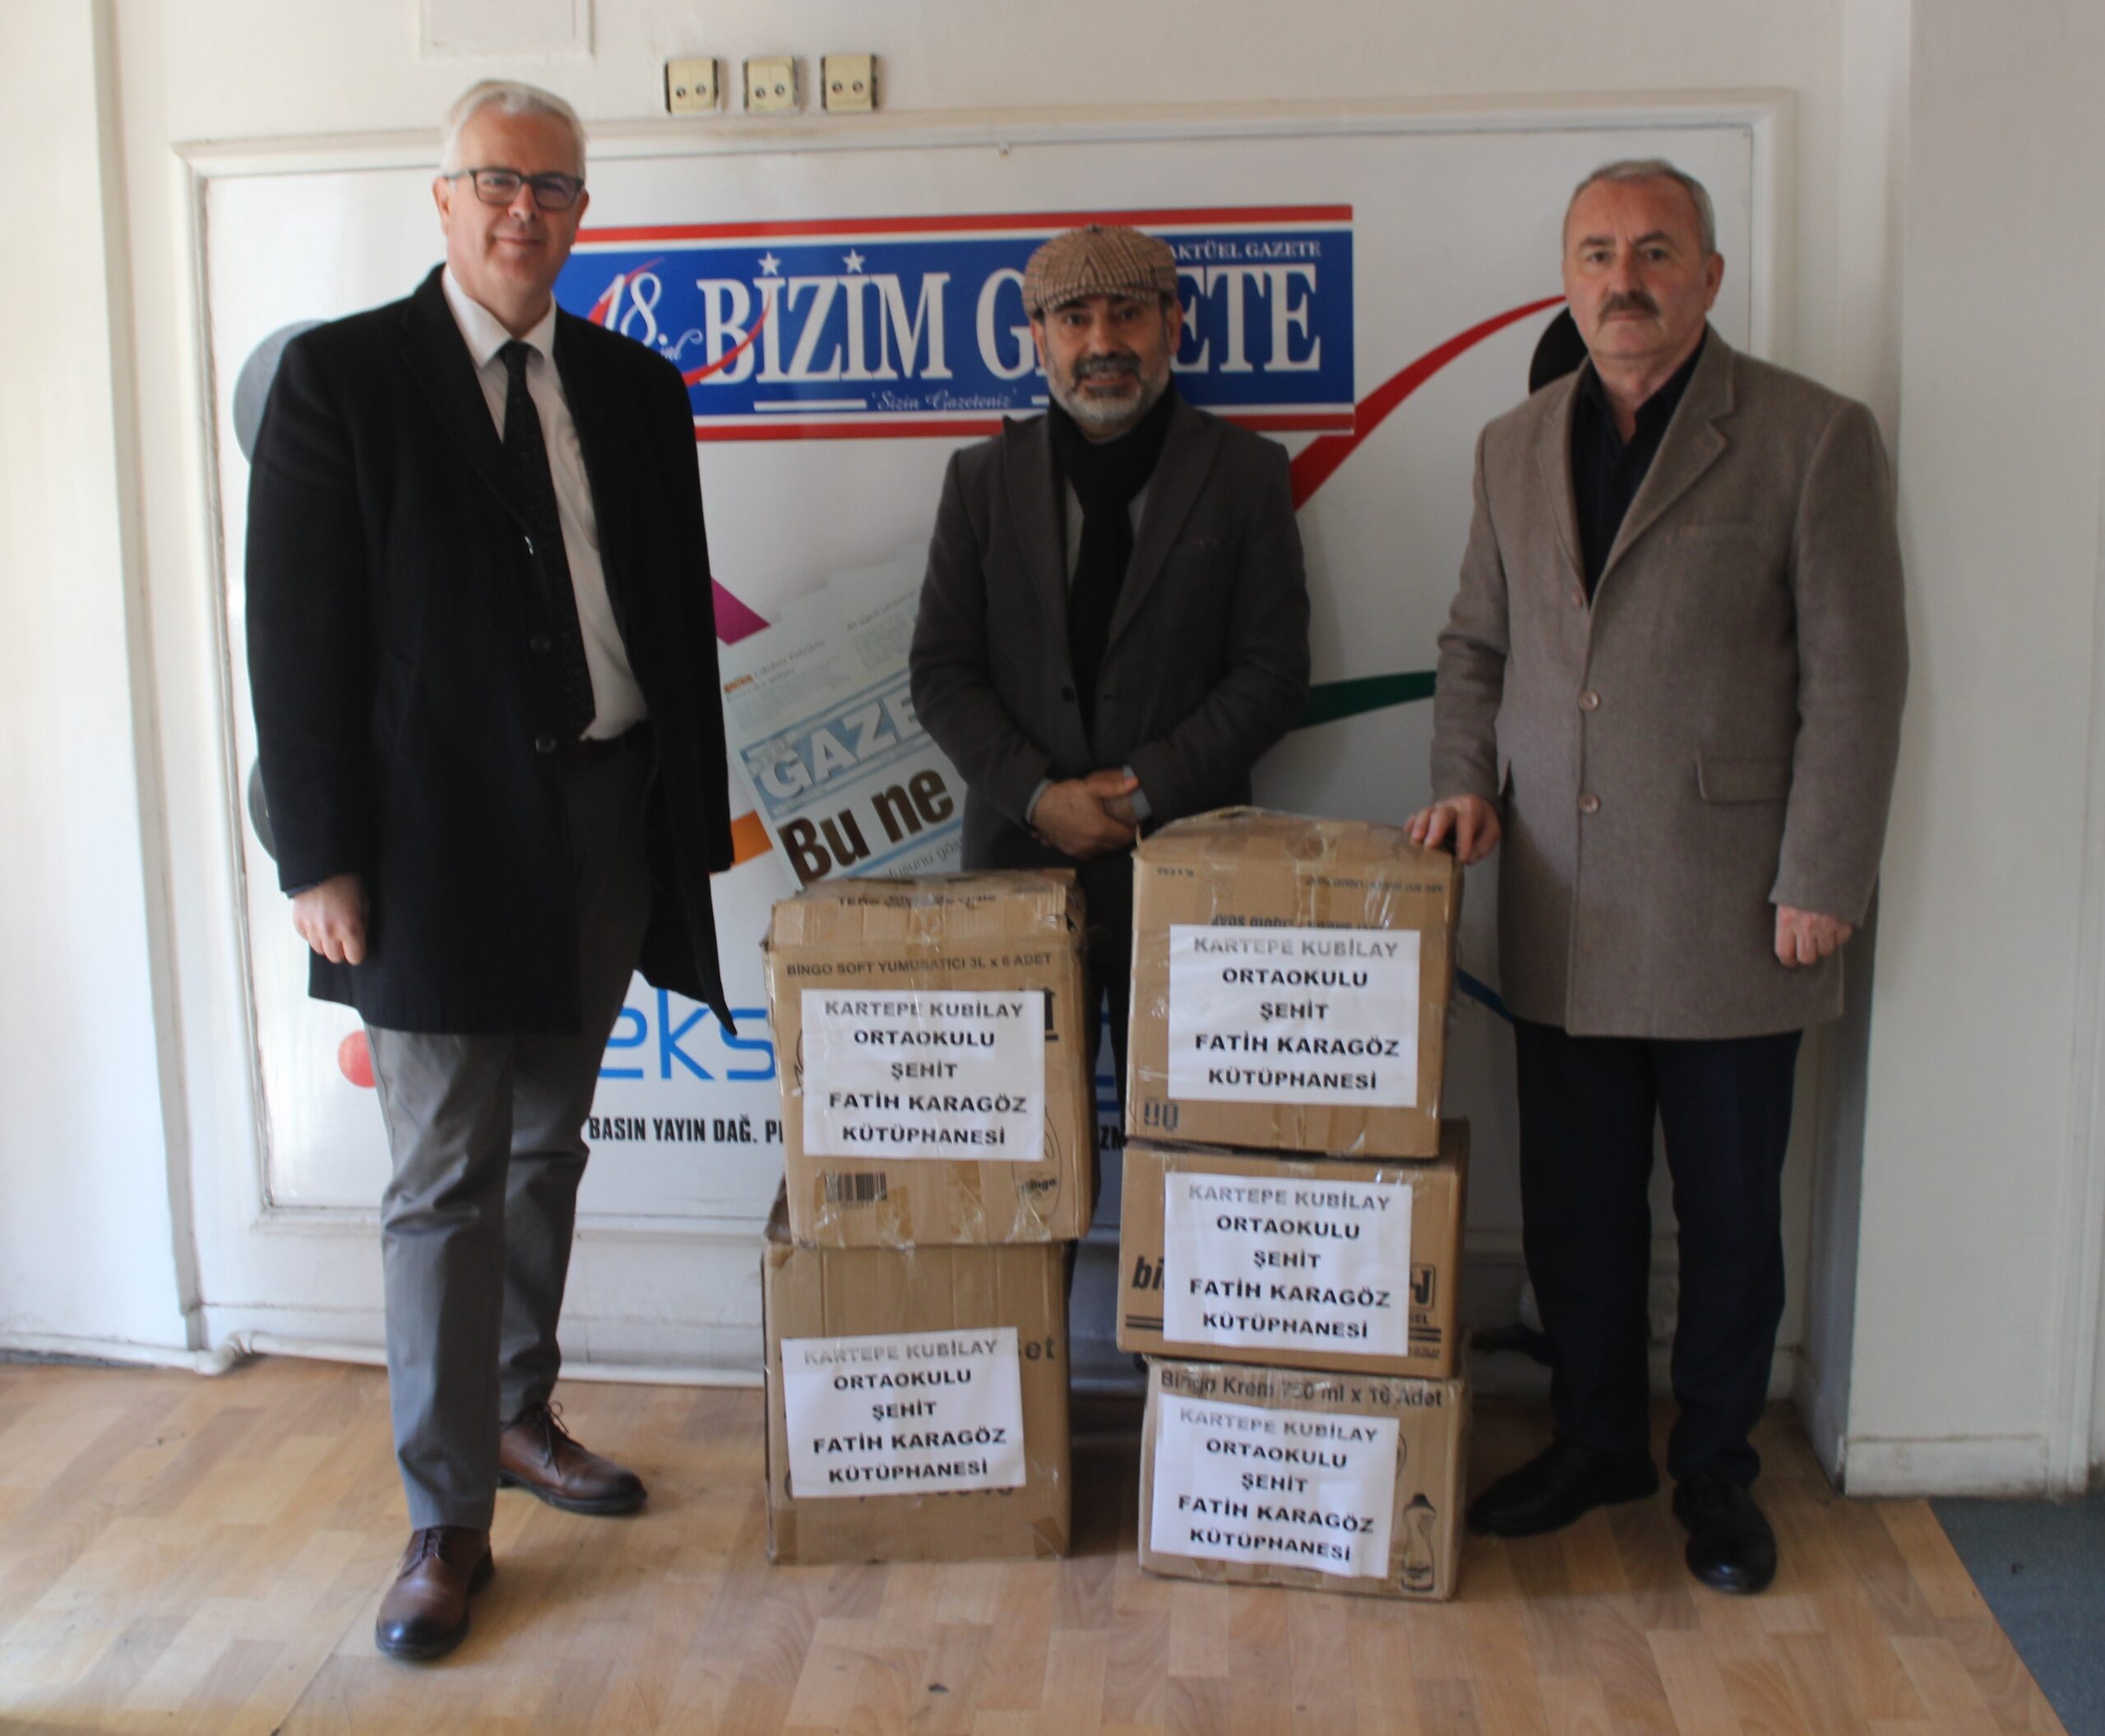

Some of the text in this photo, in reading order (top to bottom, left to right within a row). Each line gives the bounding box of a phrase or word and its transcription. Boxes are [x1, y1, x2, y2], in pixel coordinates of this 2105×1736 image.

[1245, 240, 1321, 259] GAZETE
[696, 249, 1321, 384] BİZİM GETE
[777, 808, 870, 882] Bu
[871, 769, 954, 844] ne
[1194, 937, 1399, 958] KARTEPE KUBİLAY
[786, 963, 833, 976] BİNGO
[836, 962, 873, 974] SOFT
[1014, 951, 1052, 965] ADET
[1222, 969, 1368, 987] ORTAOKULU
[825, 1001, 1023, 1018] KARTEPE KUBİLAY
[1260, 1001, 1328, 1021] ŞEHİT
[854, 1030, 995, 1047] ORTAOKULU
[1196, 1032, 1399, 1056] FATİH KARAGÖZ
[891, 1062, 958, 1081] ŞEHİT
[1209, 1068, 1376, 1090] KÜTÜPHANESİ
[829, 1092, 1026, 1113] FATİH KARAGÖZ
[589, 1117, 645, 1141] BASIN
[653, 1118, 710, 1141] YAYIN
[713, 1114, 758, 1143] DAĞ.
[842, 1125, 1005, 1145] KÜTÜPHANESİ
[1188, 1185, 1390, 1211] KARTEPE KUBİLAY
[1216, 1215, 1360, 1239] ORTAOKULU
[1254, 1250, 1321, 1269] ŞEHİT
[1190, 1279, 1390, 1308] FATİH KARAGÖZ
[1203, 1313, 1367, 1339] KÜTÜPHANESİ
[804, 1339, 997, 1364] KARTEPE KUBİLAY
[833, 1369, 971, 1391] ORTAOKULU
[1321, 1385, 1345, 1403] ml
[1350, 1390, 1362, 1405] x
[872, 1400, 937, 1422] ŞEHİT
[1180, 1405, 1377, 1442] KARTEPE KUBİLAY
[813, 1427, 1006, 1454] FATİH KARAGÖZ
[1205, 1440, 1347, 1468] ORTAOKULU
[828, 1460, 988, 1484] KÜTÜPHANESİ
[1242, 1474, 1307, 1493] ŞEHİT
[1178, 1495, 1374, 1534] FATİH KARAGÖZ
[1188, 1528, 1353, 1563] KÜTÜPHANESİ
